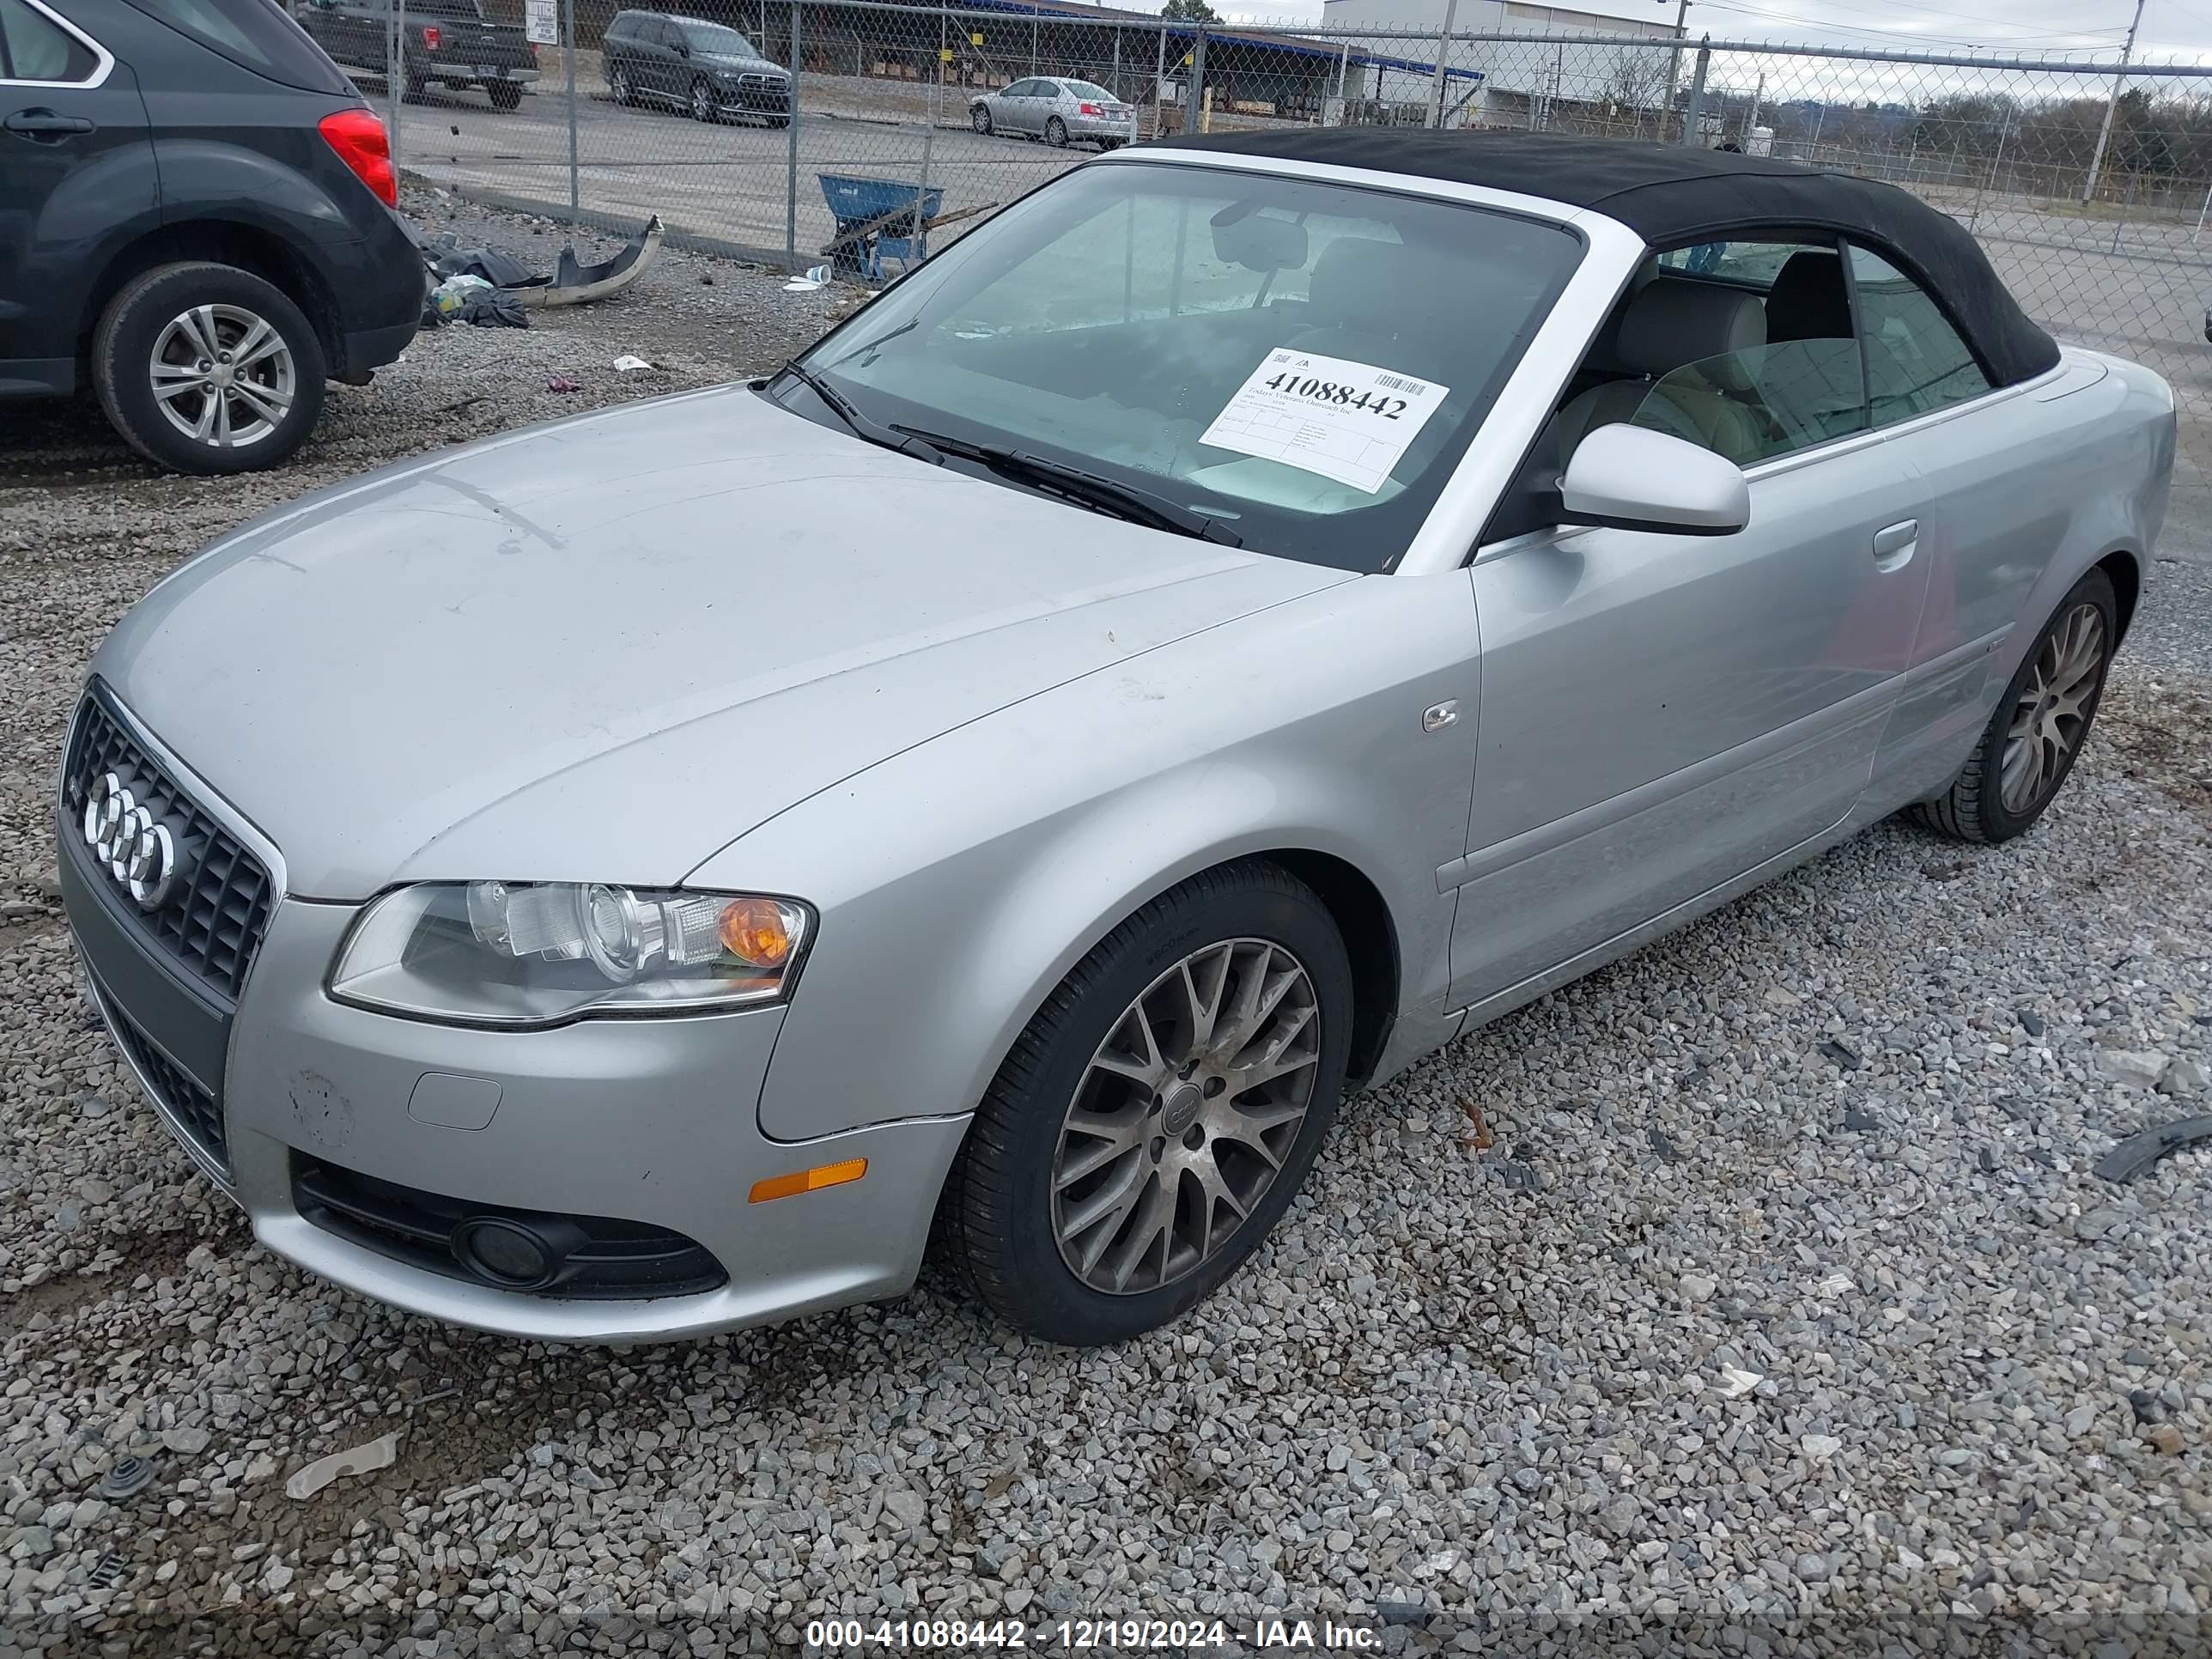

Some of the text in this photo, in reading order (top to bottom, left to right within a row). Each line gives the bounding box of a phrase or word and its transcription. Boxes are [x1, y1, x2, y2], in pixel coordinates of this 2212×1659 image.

[1249, 387, 1352, 415] Todays Veterans Outreach Inc
[1265, 372, 1407, 420] 41088442
